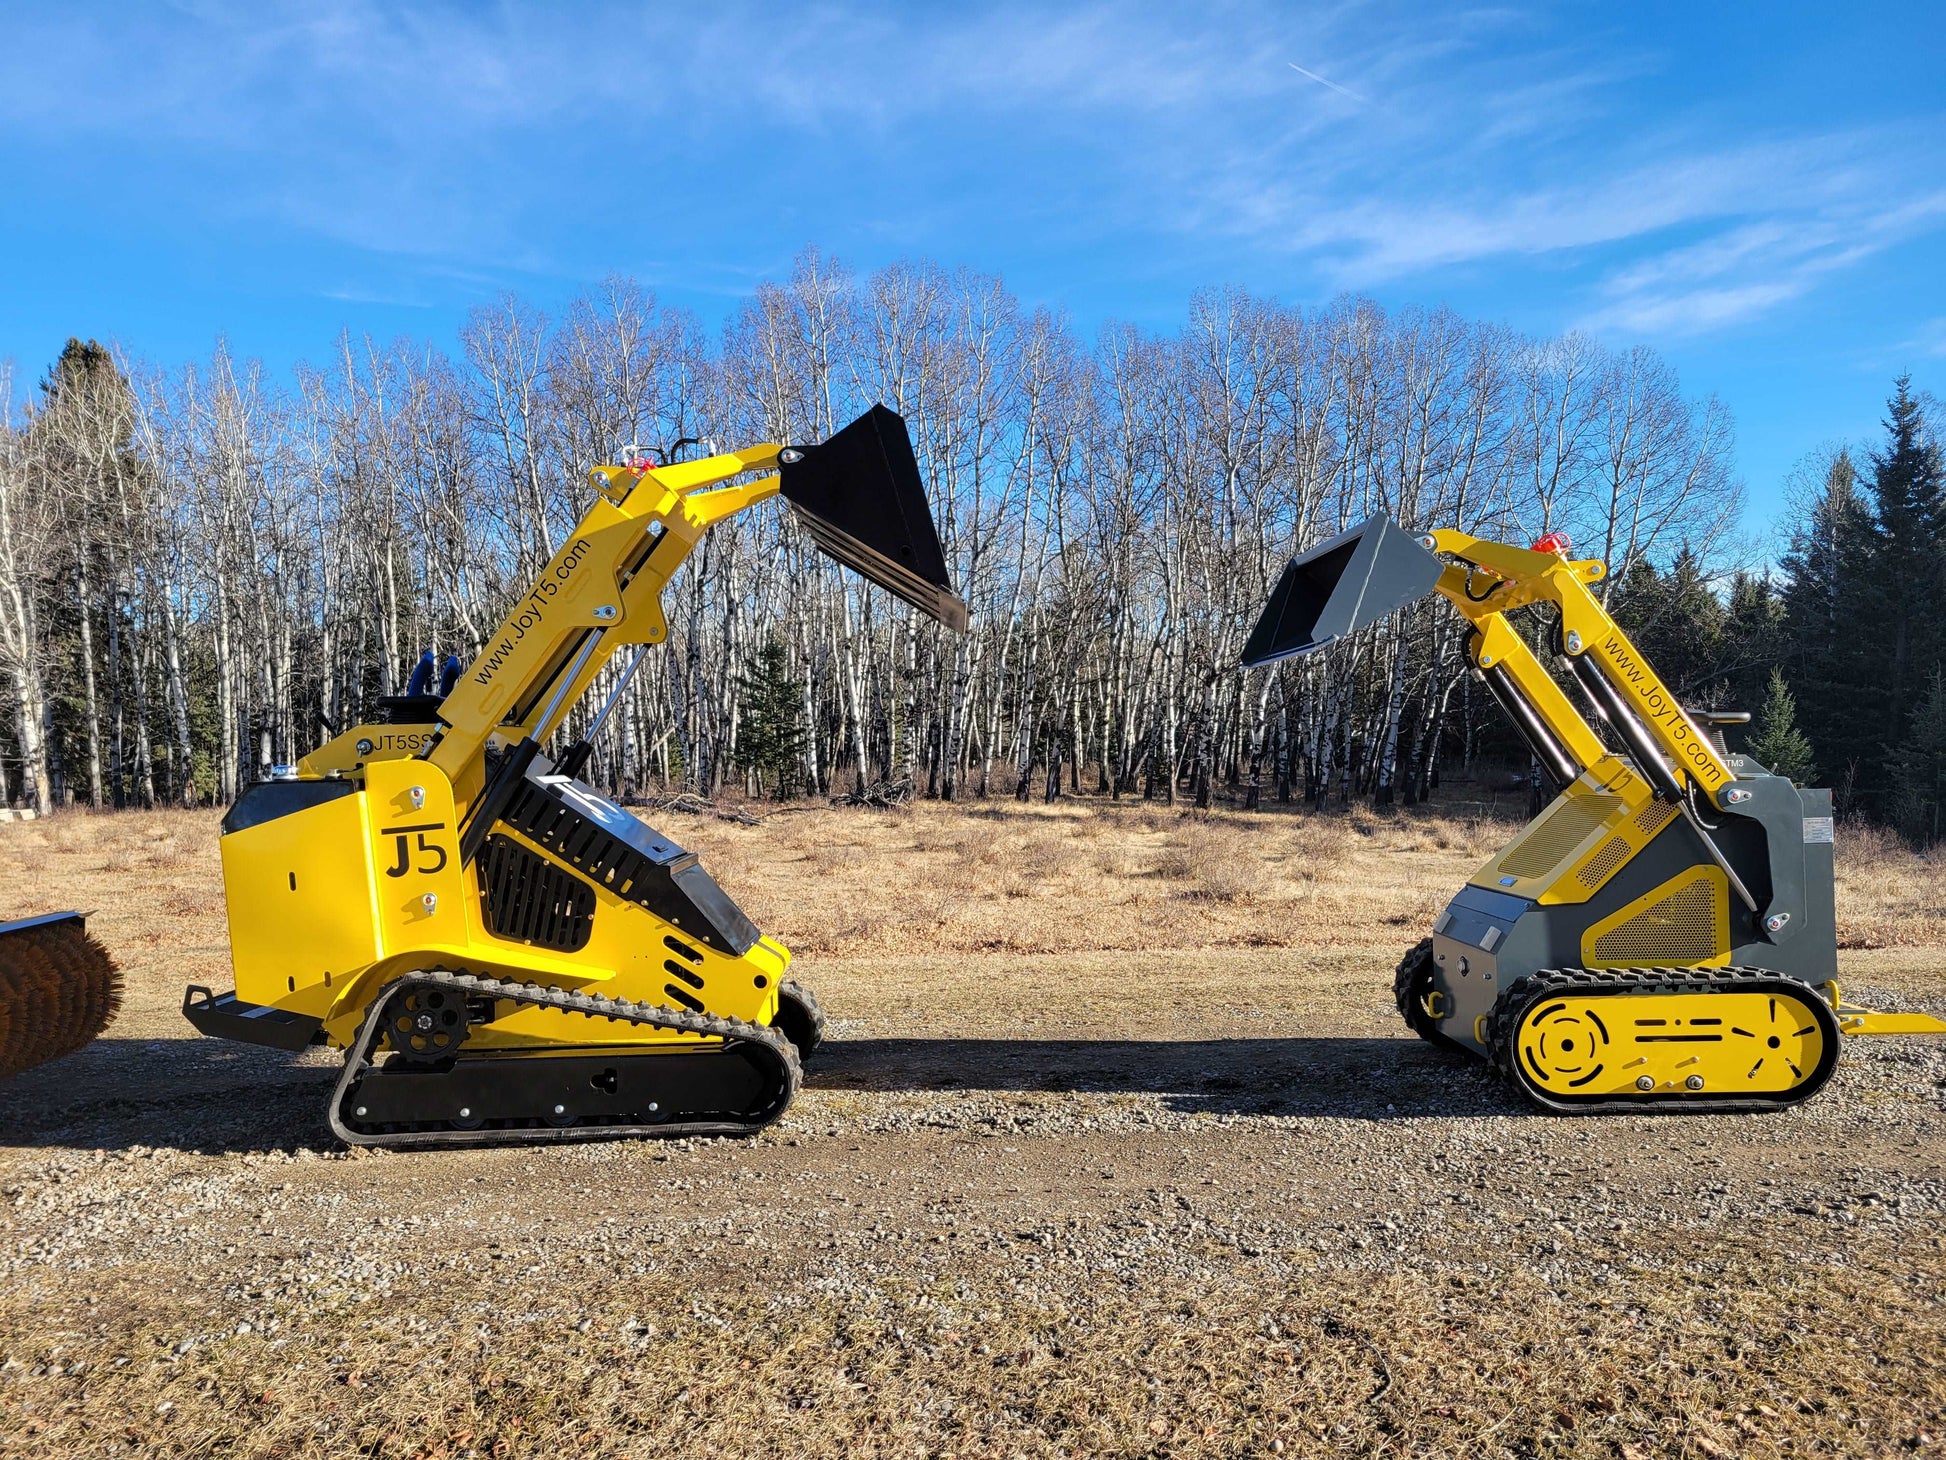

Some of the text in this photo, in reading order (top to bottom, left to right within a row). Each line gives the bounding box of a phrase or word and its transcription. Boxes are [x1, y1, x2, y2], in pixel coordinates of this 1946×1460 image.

[474, 539, 591, 685] www.JoyT5.com
[1604, 637, 1721, 783] www.JoyT5.com
[381, 822, 448, 878] J5
